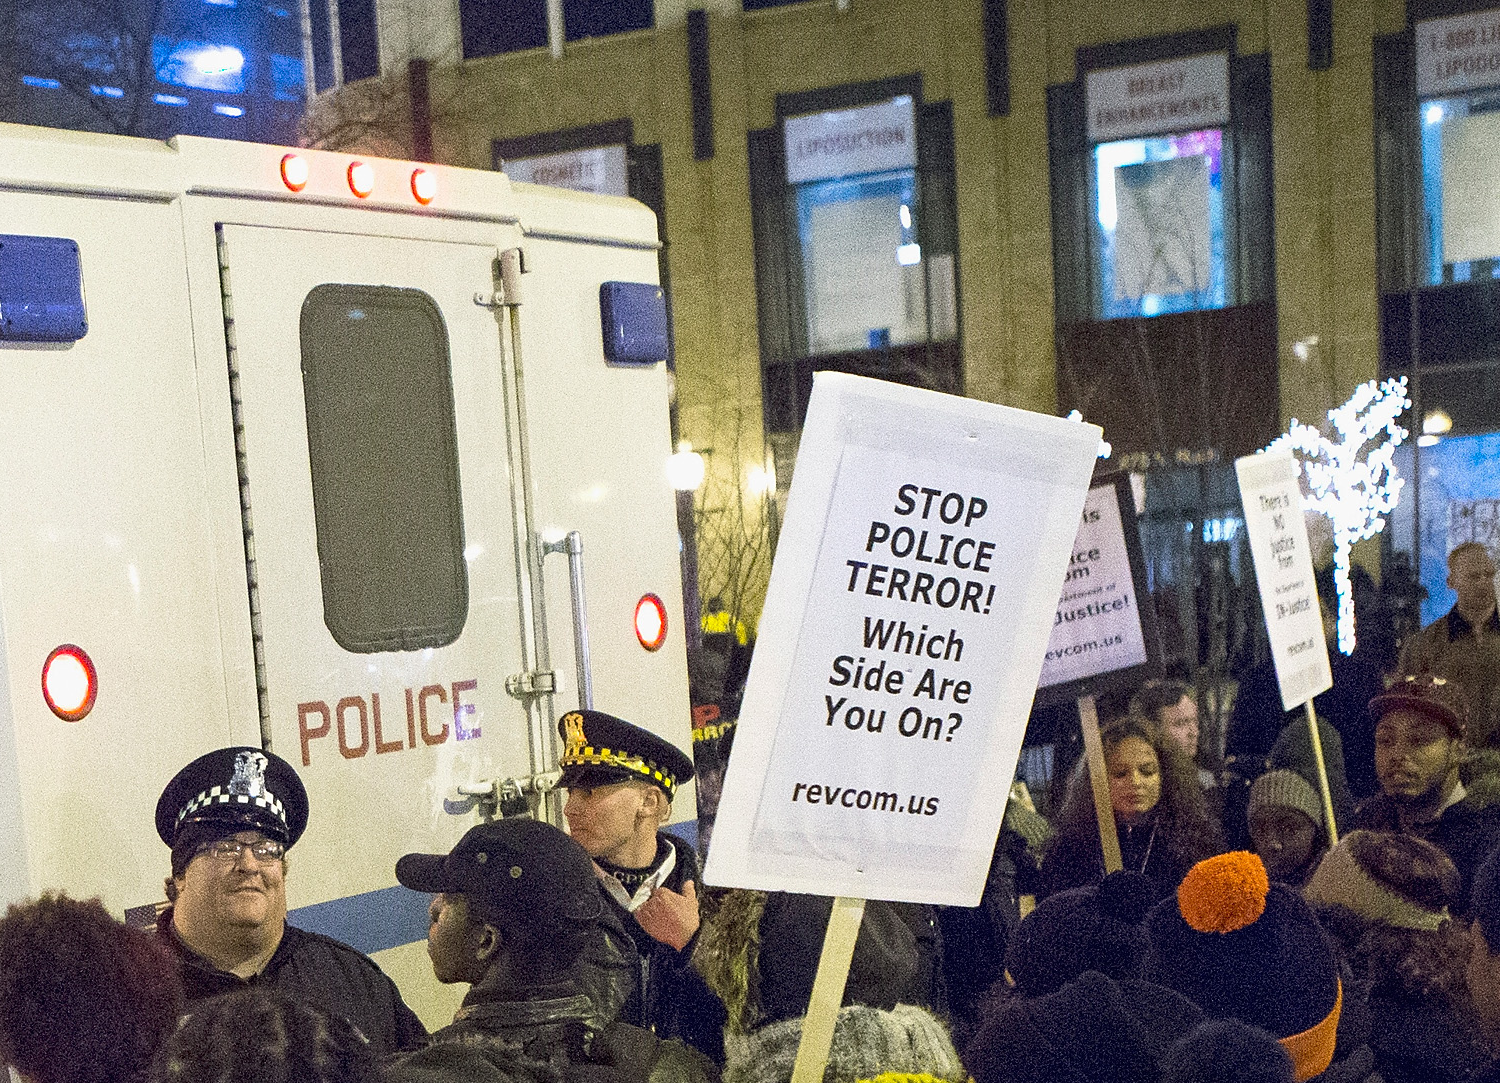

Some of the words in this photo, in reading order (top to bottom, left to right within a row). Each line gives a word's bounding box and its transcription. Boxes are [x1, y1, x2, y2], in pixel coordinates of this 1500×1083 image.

[1126, 72, 1186, 97] BREAST
[1096, 93, 1221, 128] ENHANCEMENTS
[796, 126, 906, 160] LIPOSUCTION
[893, 483, 989, 528] STOP
[1082, 508, 1101, 525] is
[865, 521, 997, 573] POLICE
[846, 559, 997, 615] TERROR!
[862, 616, 965, 662] Which
[1045, 634, 1123, 661] evcom.us
[828, 655, 905, 695] Side
[912, 668, 973, 705] Are
[297, 678, 482, 767] POLICE
[824, 695, 887, 733] You
[898, 706, 964, 743] On?
[791, 781, 940, 816] revcom.us
